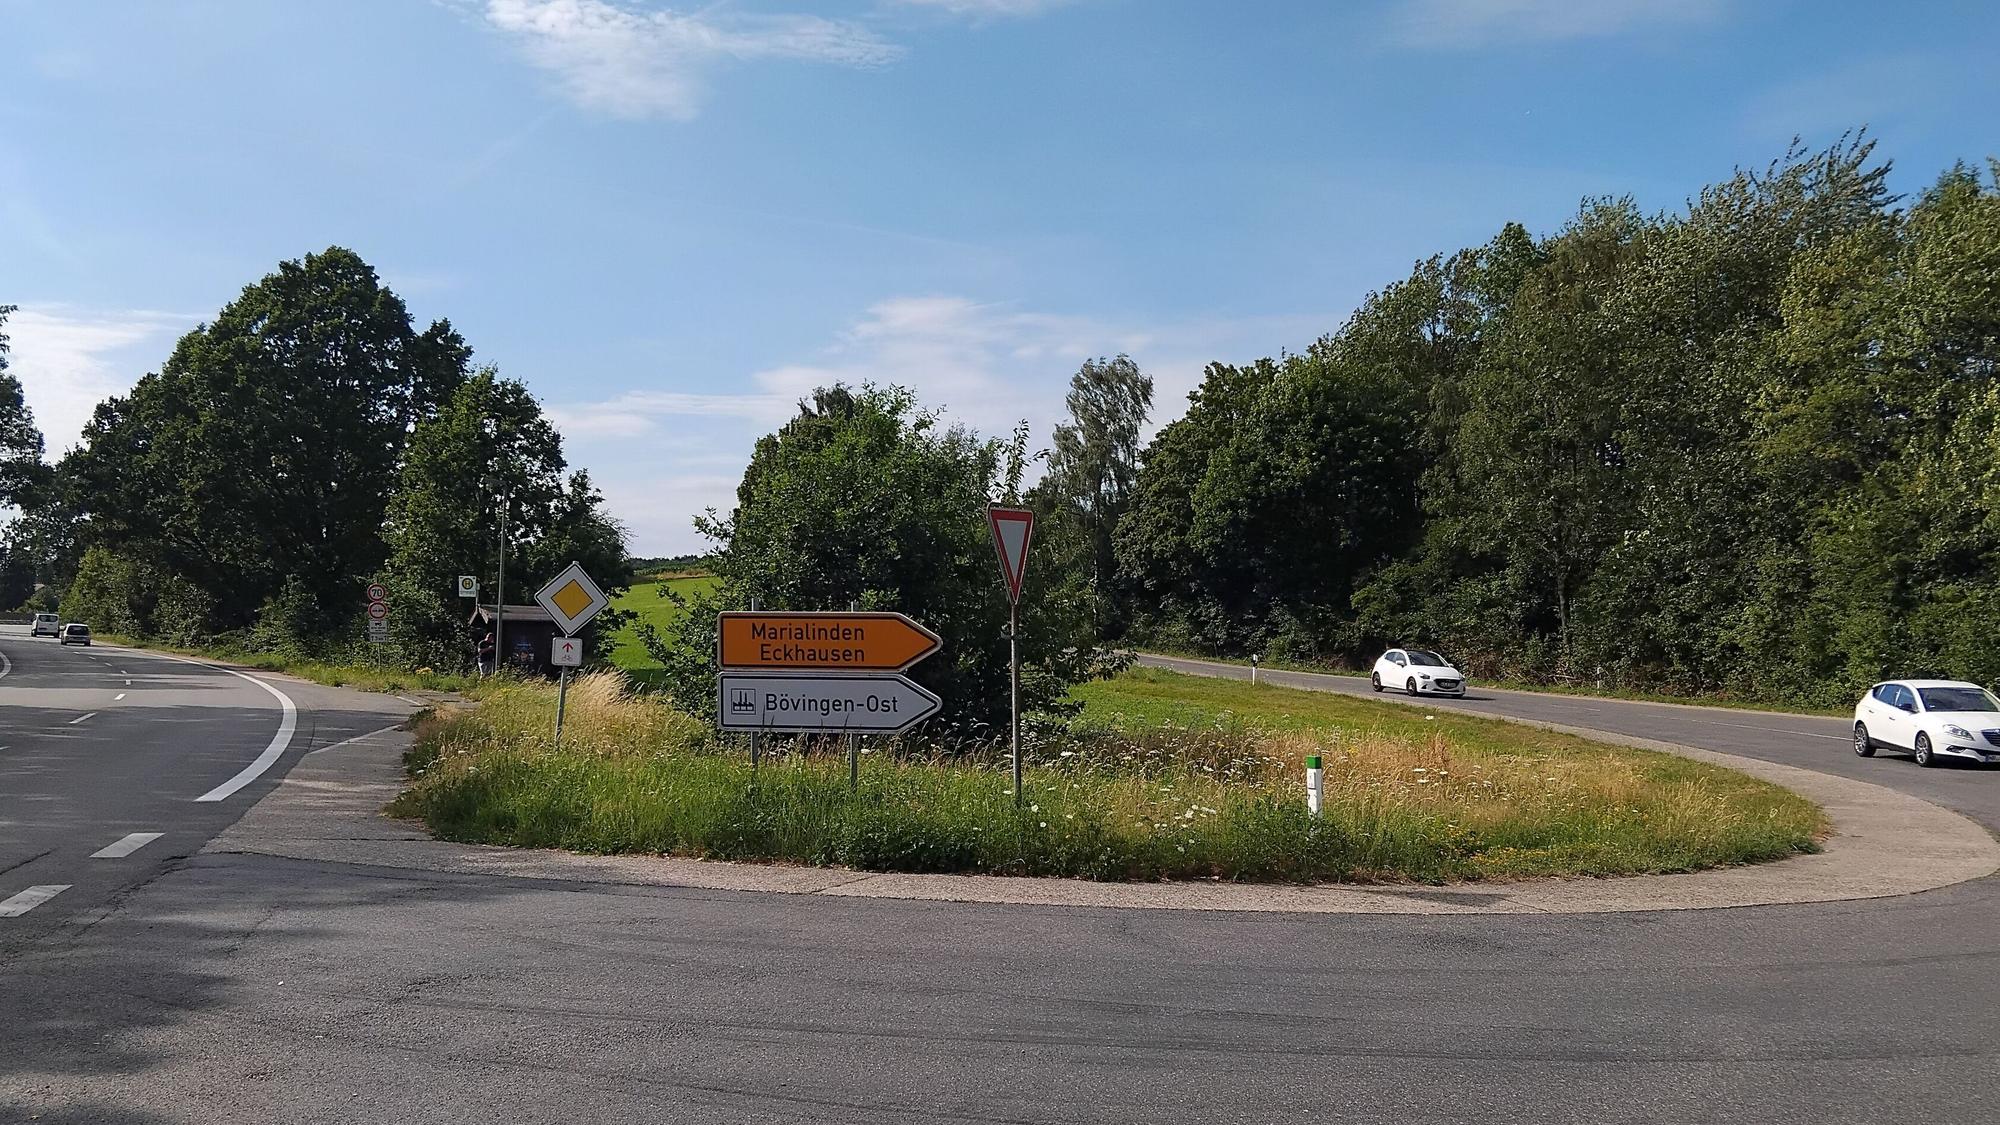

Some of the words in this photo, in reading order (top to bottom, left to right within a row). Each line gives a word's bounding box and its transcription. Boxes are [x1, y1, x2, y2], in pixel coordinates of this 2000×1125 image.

[371, 589, 382, 597] 70
[751, 622, 865, 641] Marialinden
[760, 643, 865, 662] Eckhausen
[765, 693, 898, 716] Bövingen-Ost
